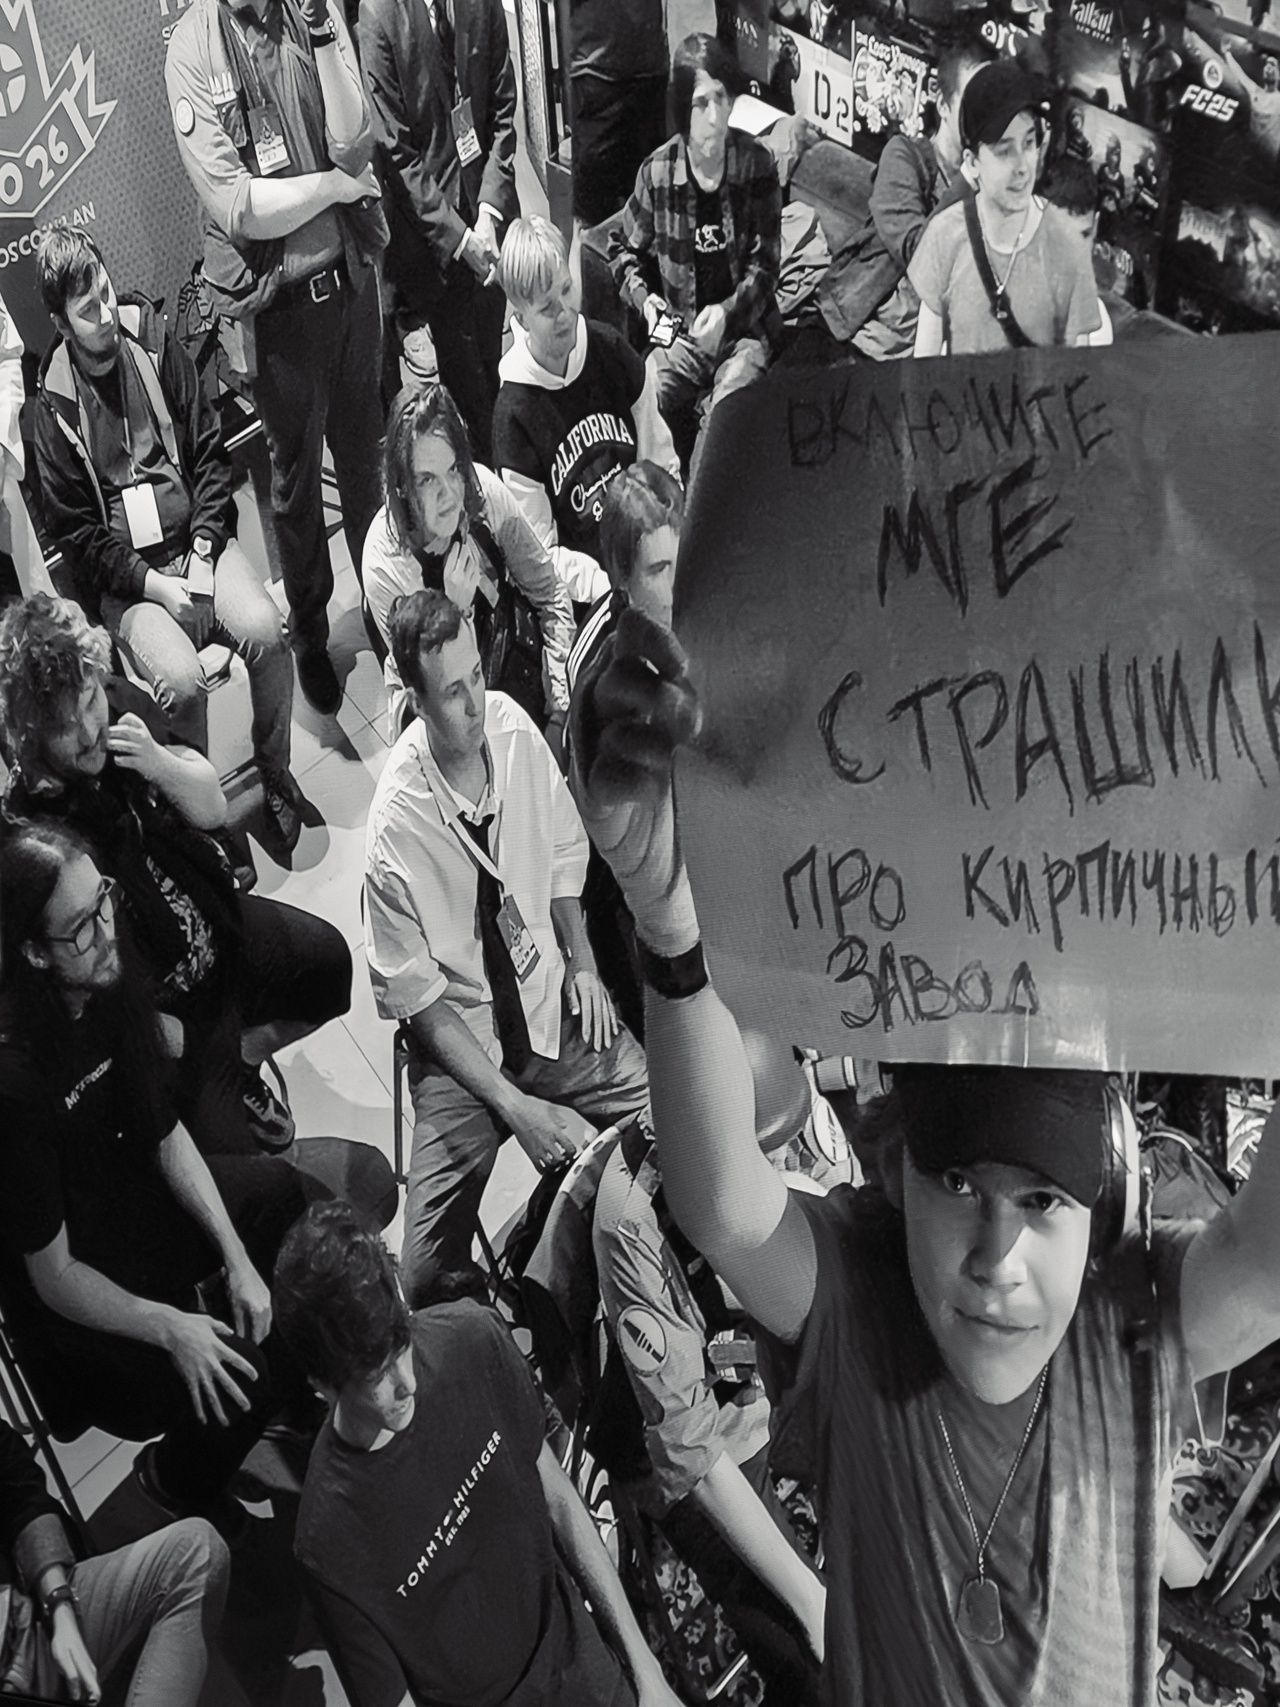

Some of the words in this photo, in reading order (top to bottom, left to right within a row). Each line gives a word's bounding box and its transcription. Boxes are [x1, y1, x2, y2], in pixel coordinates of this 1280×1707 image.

[551, 412, 635, 496] CALIFORNIA
[788, 373, 1114, 467] ВКЛЮЧИТЕ
[877, 454, 1075, 619] МГЕ
[782, 845, 906, 938] ПРО
[826, 934, 1040, 1033] ЗАВОД
[396, 1525, 444, 1598] TOMMY
[453, 1430, 502, 1509] HILFIGER
